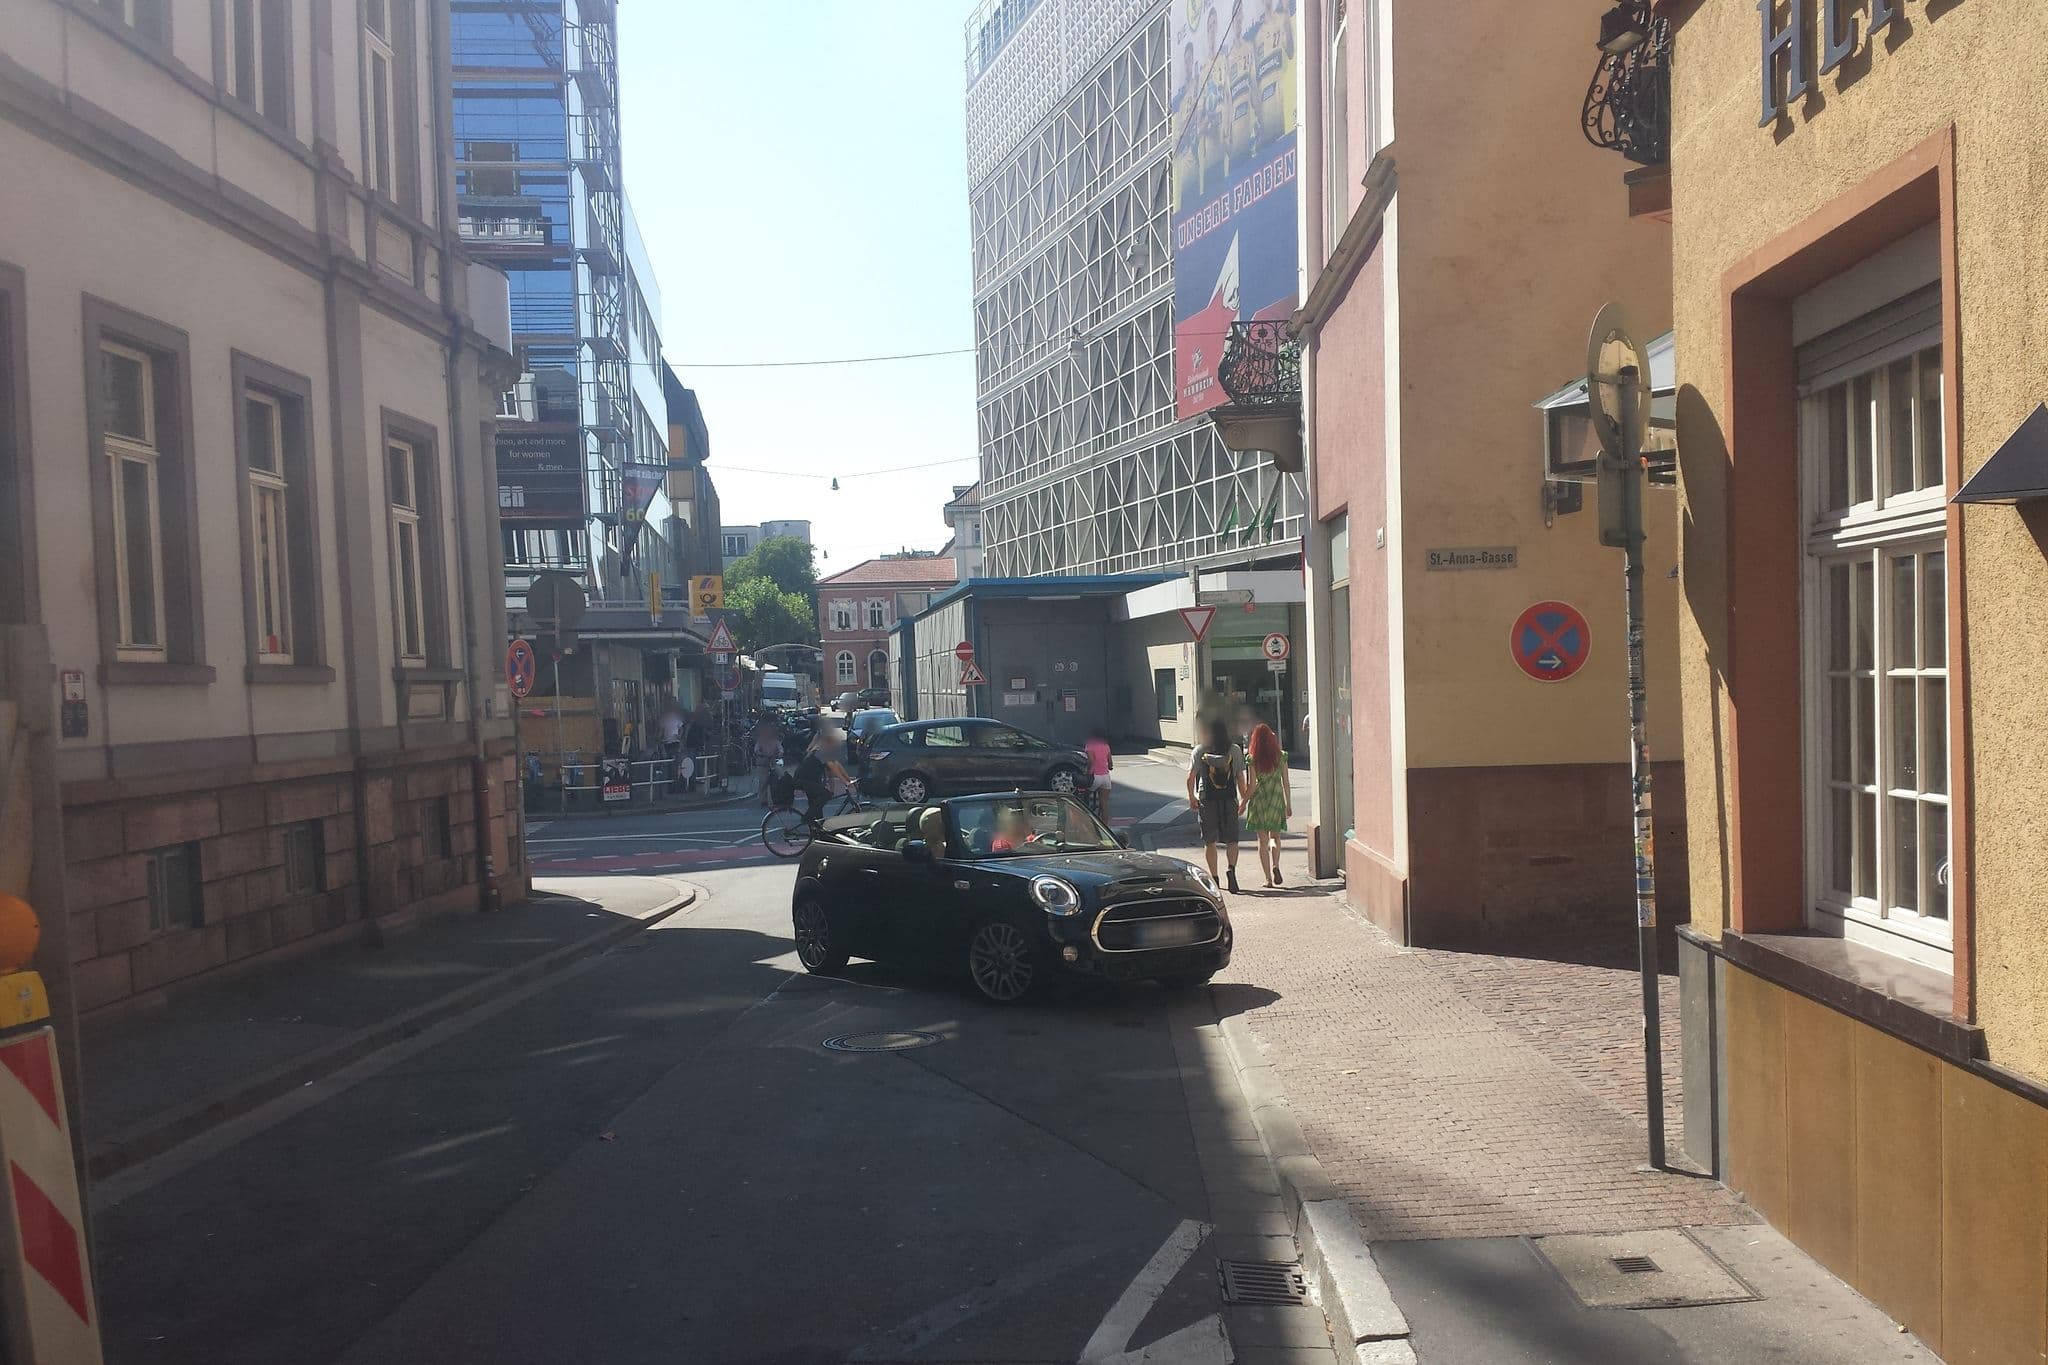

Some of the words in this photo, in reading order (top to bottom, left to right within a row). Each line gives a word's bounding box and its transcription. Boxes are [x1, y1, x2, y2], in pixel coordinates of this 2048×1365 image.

[1178, 193, 1230, 249] UNSERE
[1234, 148, 1296, 213] FARBEN
[509, 450, 520, 459] for
[521, 451, 551, 459] women
[1430, 551, 1514, 566] St.-Anna-Gasse
[604, 784, 631, 794] LIEBE
